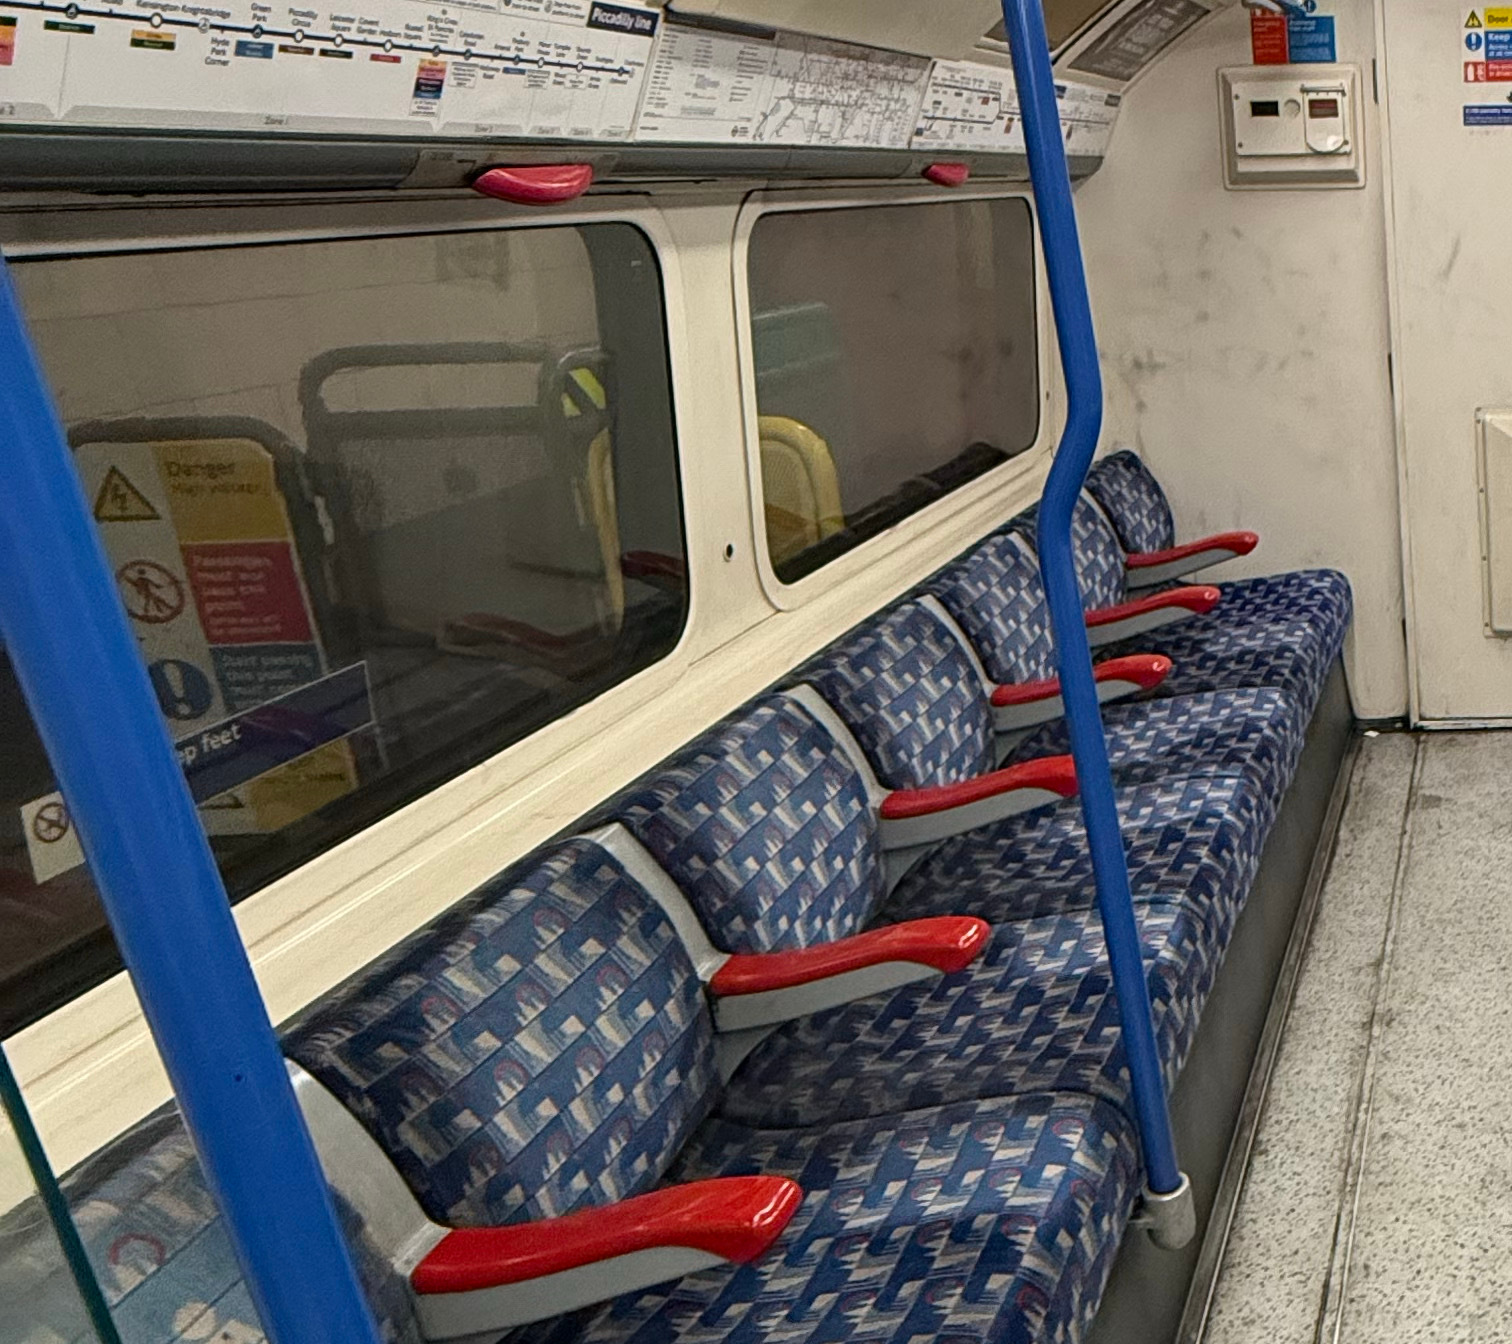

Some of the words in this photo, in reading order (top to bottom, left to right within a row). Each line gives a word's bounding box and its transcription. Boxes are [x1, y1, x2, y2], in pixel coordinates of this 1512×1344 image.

[591, 6, 634, 29] Piccadilly
[634, 12, 653, 30] line
[1487, 14, 1508, 24] Door
[1487, 32, 1510, 43] Keep
[165, 460, 236, 480] Danger
[203, 722, 242, 747] feet
